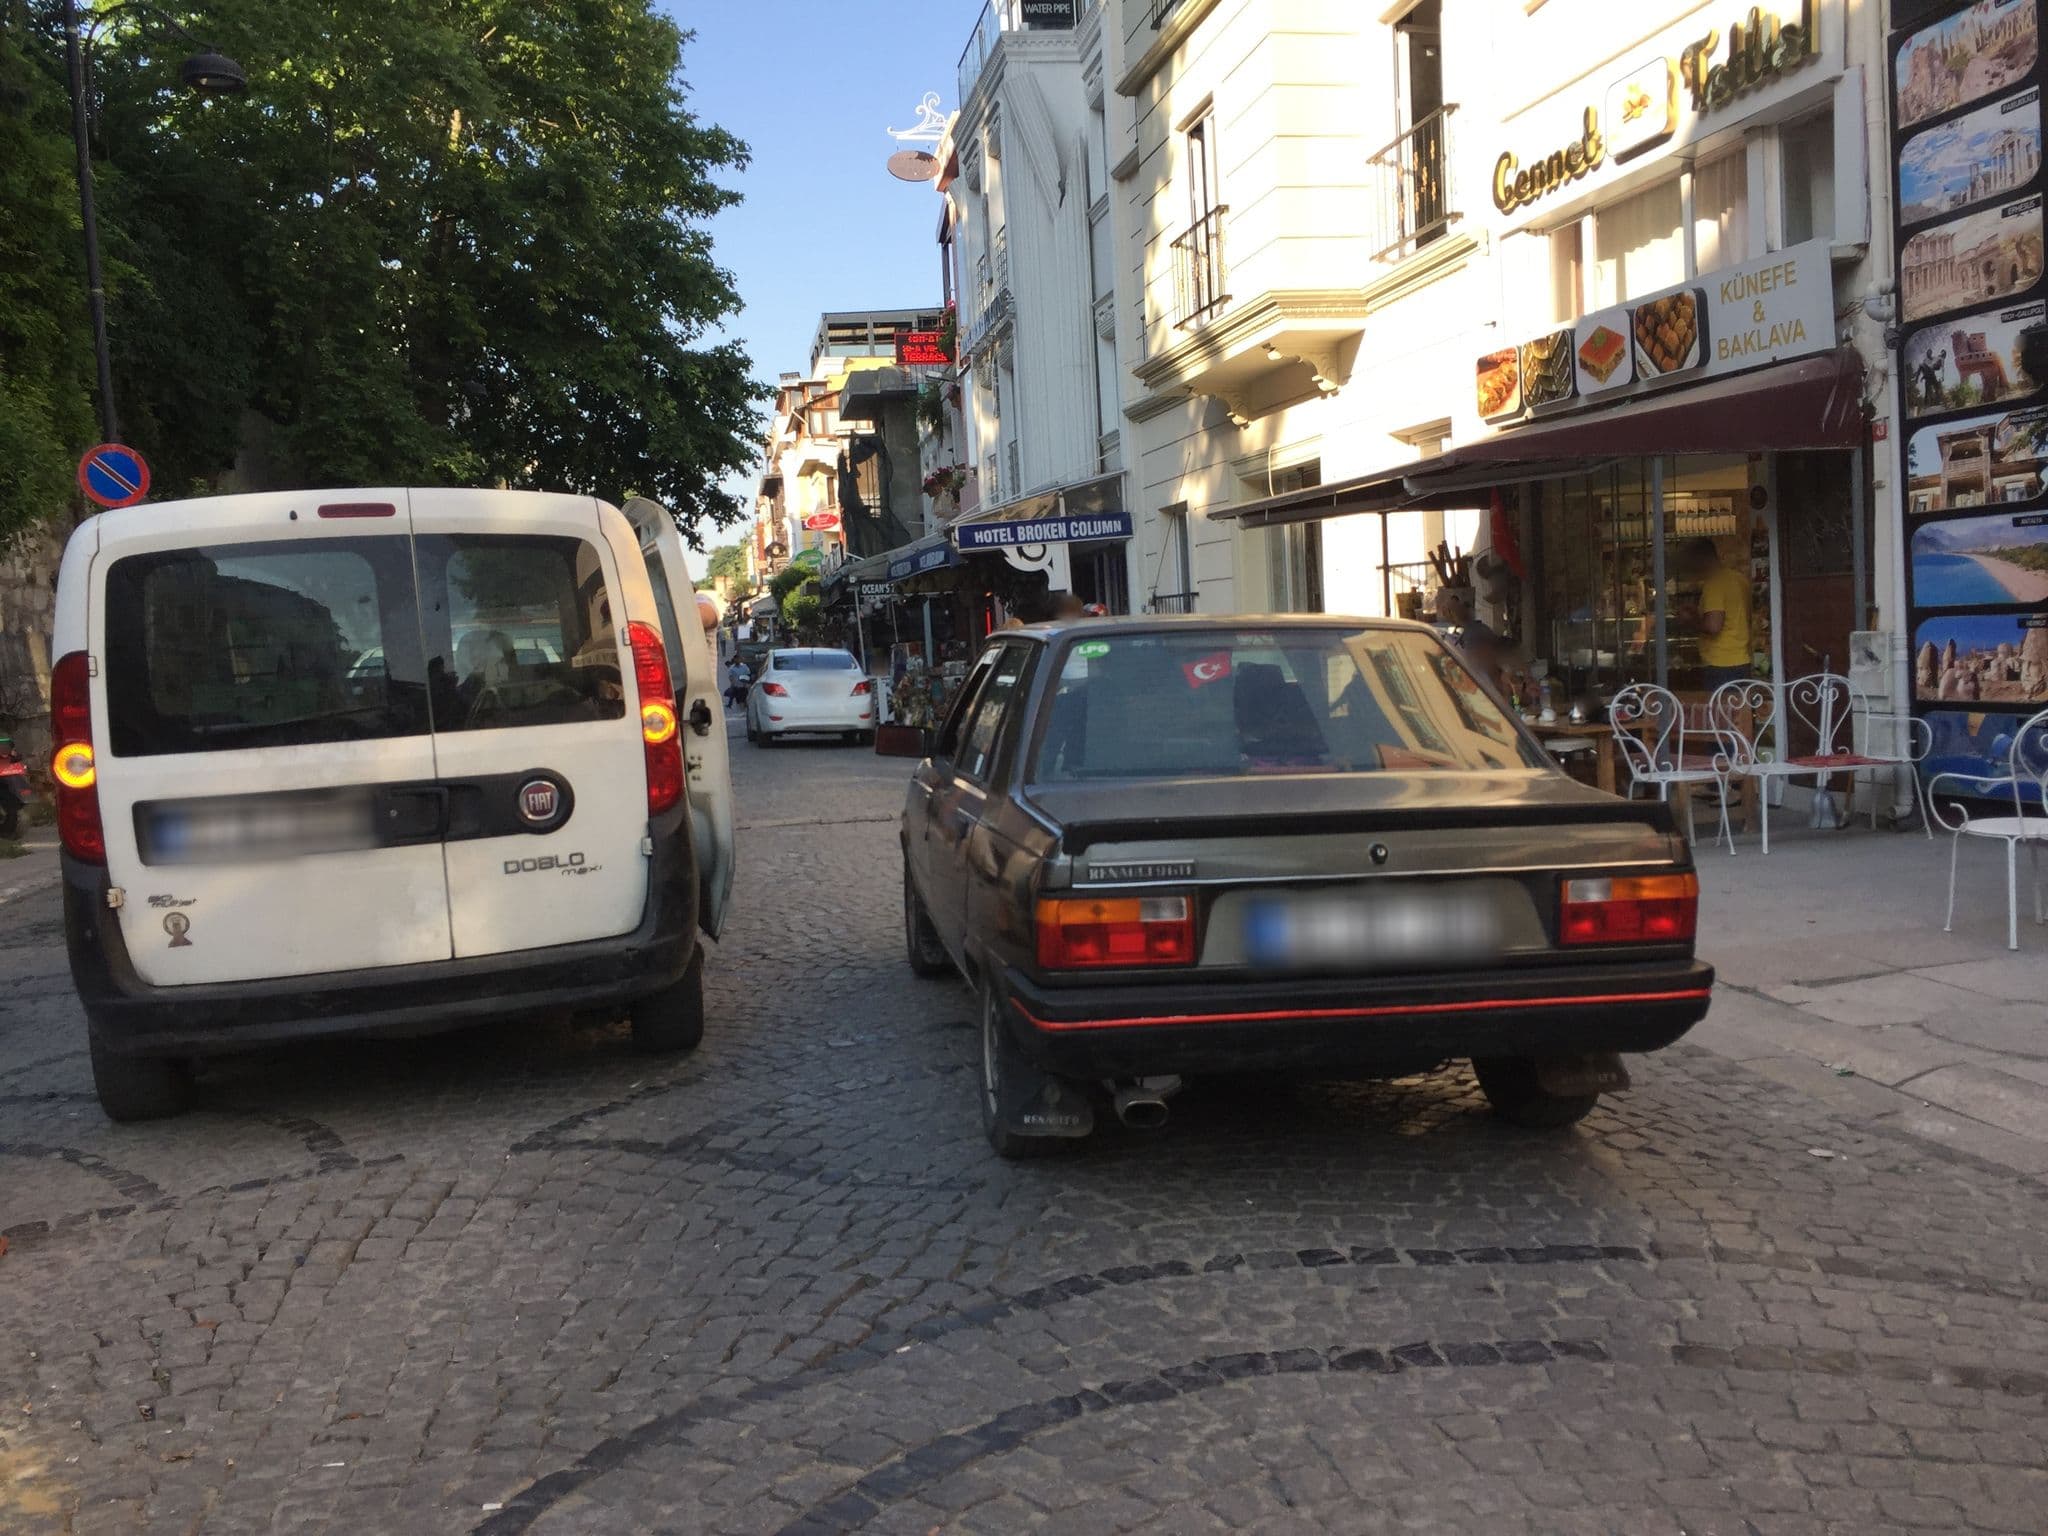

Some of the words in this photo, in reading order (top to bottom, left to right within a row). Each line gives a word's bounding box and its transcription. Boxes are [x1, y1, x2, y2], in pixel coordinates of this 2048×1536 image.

[1024, 3, 1053, 14] WATER
[1053, 3, 1071, 14] PIPE
[1492, 105, 1603, 216] Cennet
[1720, 260, 1798, 305] KÜNEFE
[1753, 299, 1765, 322] &
[1717, 318, 1807, 361] BAKLAVA
[974, 527, 1015, 544] HOTEL
[1017, 522, 1067, 542] BROKEN
[1070, 519, 1122, 538] COLUMN
[861, 583, 890, 594] OCEAN'S
[1078, 644, 1111, 655] LPG
[528, 791, 552, 811] FIAT
[503, 852, 585, 875] DOBLO
